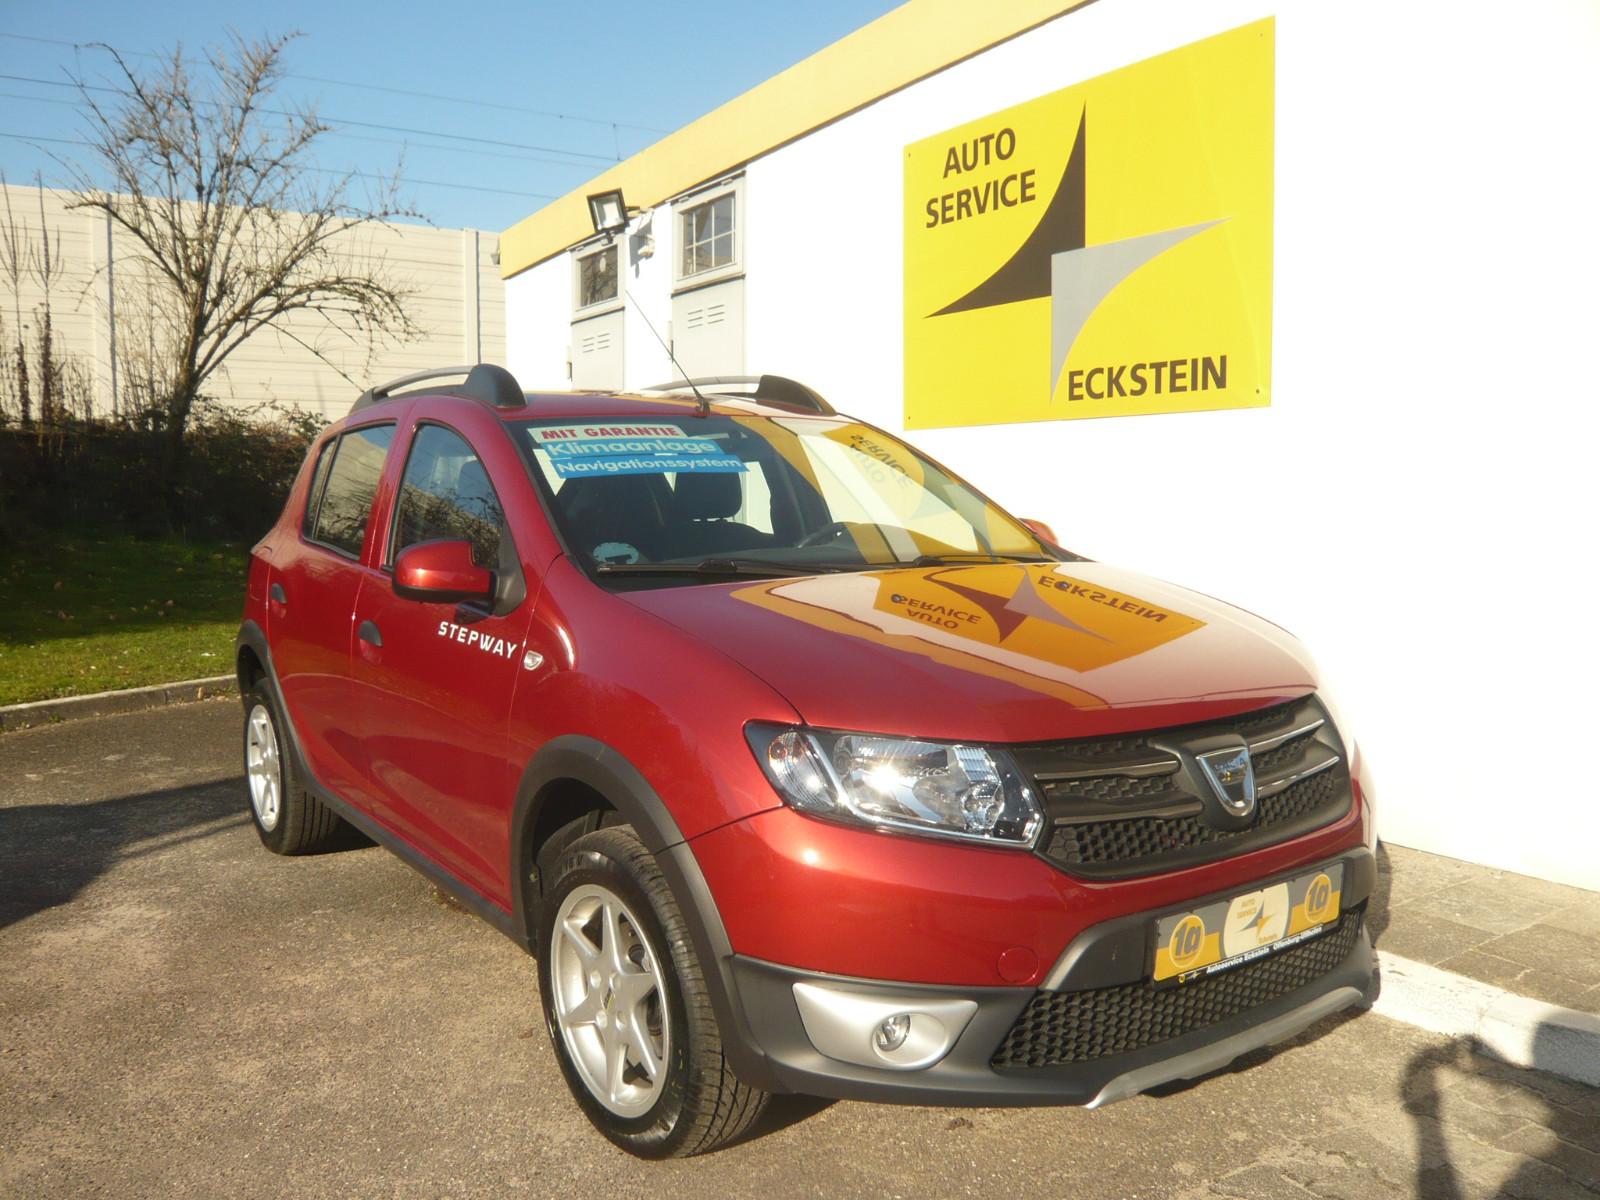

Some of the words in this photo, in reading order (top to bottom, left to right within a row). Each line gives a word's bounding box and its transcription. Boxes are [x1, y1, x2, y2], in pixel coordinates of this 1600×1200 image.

[943, 127, 1016, 178] AUTO
[926, 169, 1036, 228] SERVICE
[1068, 355, 1227, 401] ECKSTEIN
[541, 429, 577, 440] MIT
[584, 427, 680, 437] GARANTIE
[547, 439, 716, 456] Klimaanlage
[557, 458, 741, 473] Navigationssystem
[438, 621, 517, 659] STEPWAY
